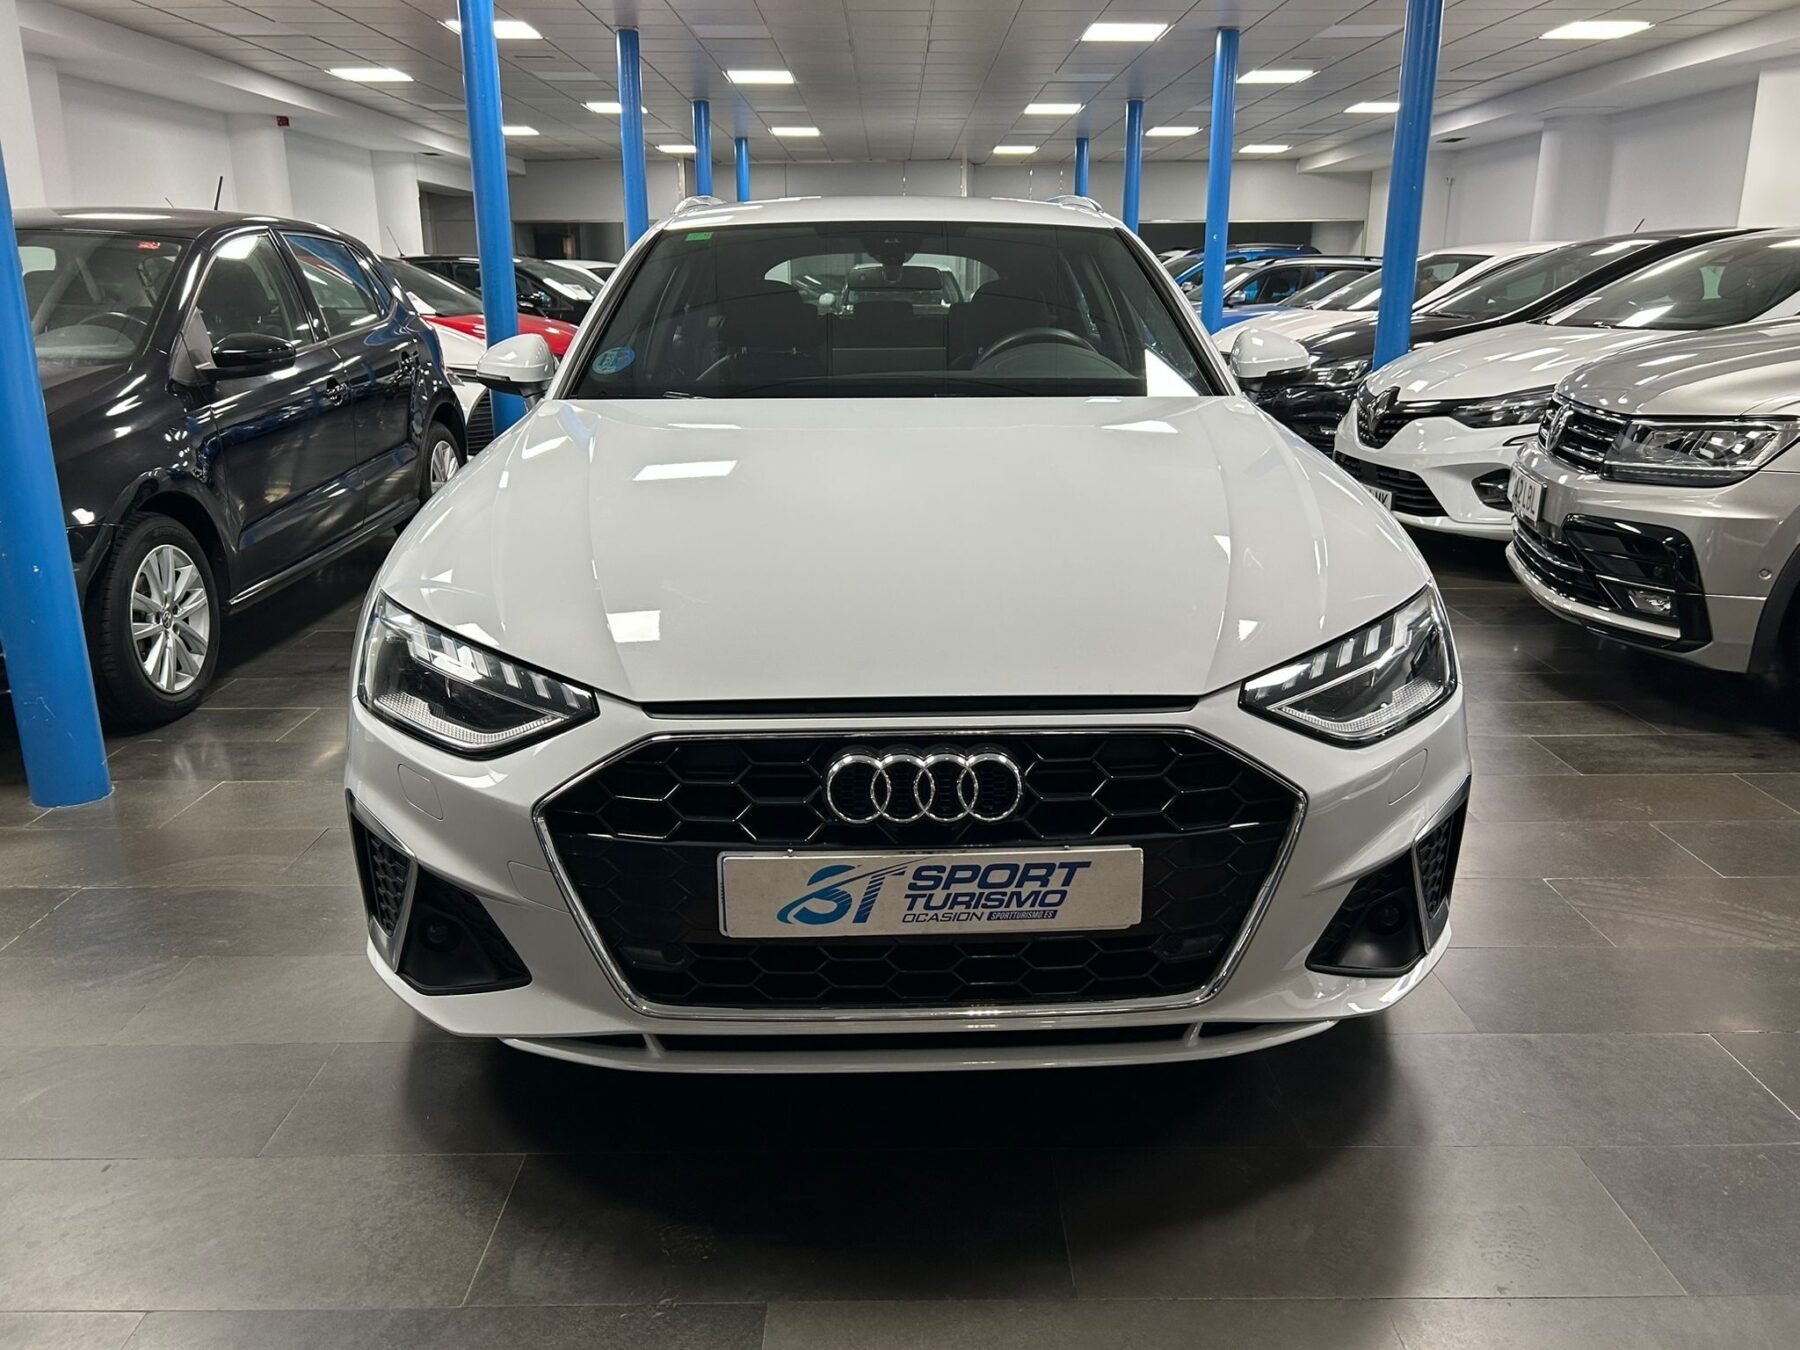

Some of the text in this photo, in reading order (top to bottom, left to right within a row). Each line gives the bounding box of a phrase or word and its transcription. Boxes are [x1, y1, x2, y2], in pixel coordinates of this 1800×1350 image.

[907, 861, 1092, 891] SPORT
[904, 889, 1068, 912] TURISMO
[902, 911, 985, 923] OCASION
